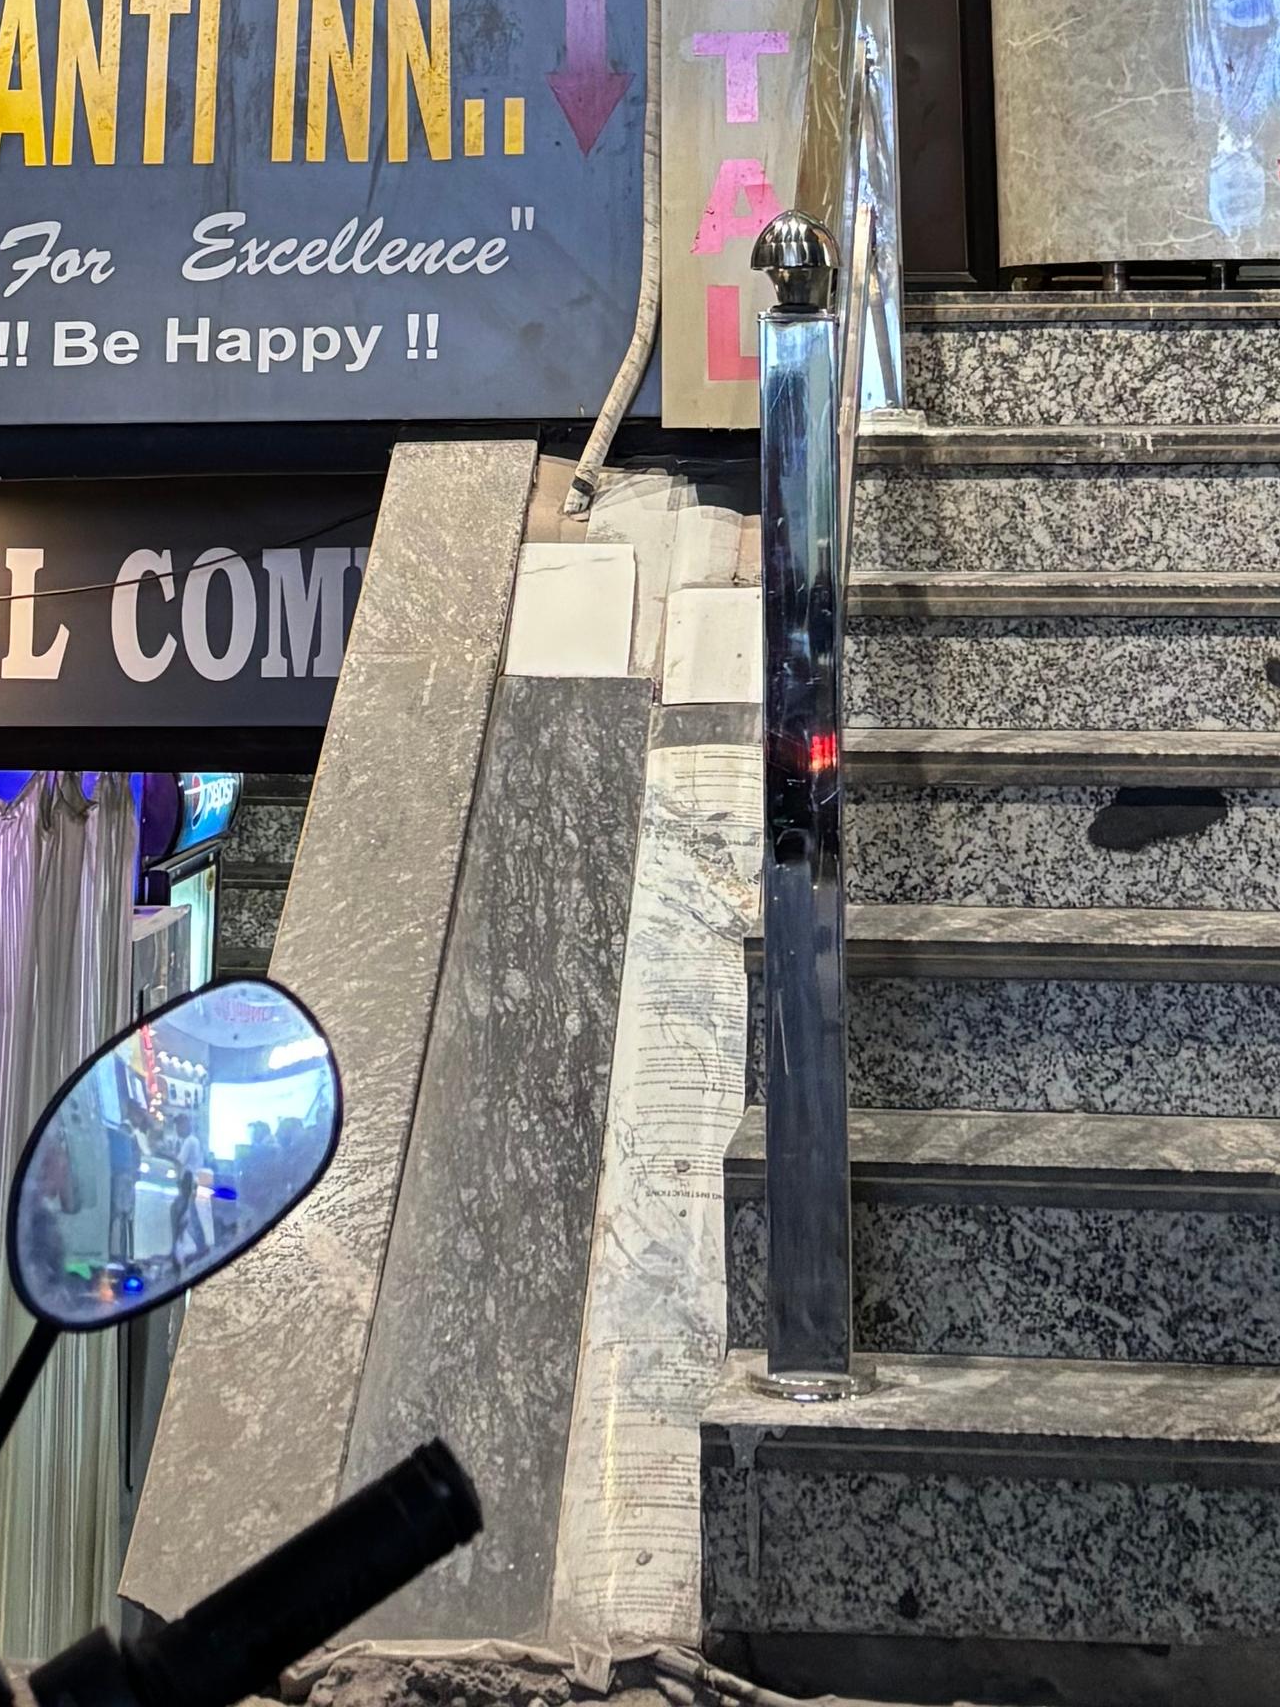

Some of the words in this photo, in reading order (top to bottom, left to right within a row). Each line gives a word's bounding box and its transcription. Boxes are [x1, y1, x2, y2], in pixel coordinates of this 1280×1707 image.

[51, 320, 140, 369] Be
[164, 314, 382, 374] Happy
[111, 546, 375, 680] COM
